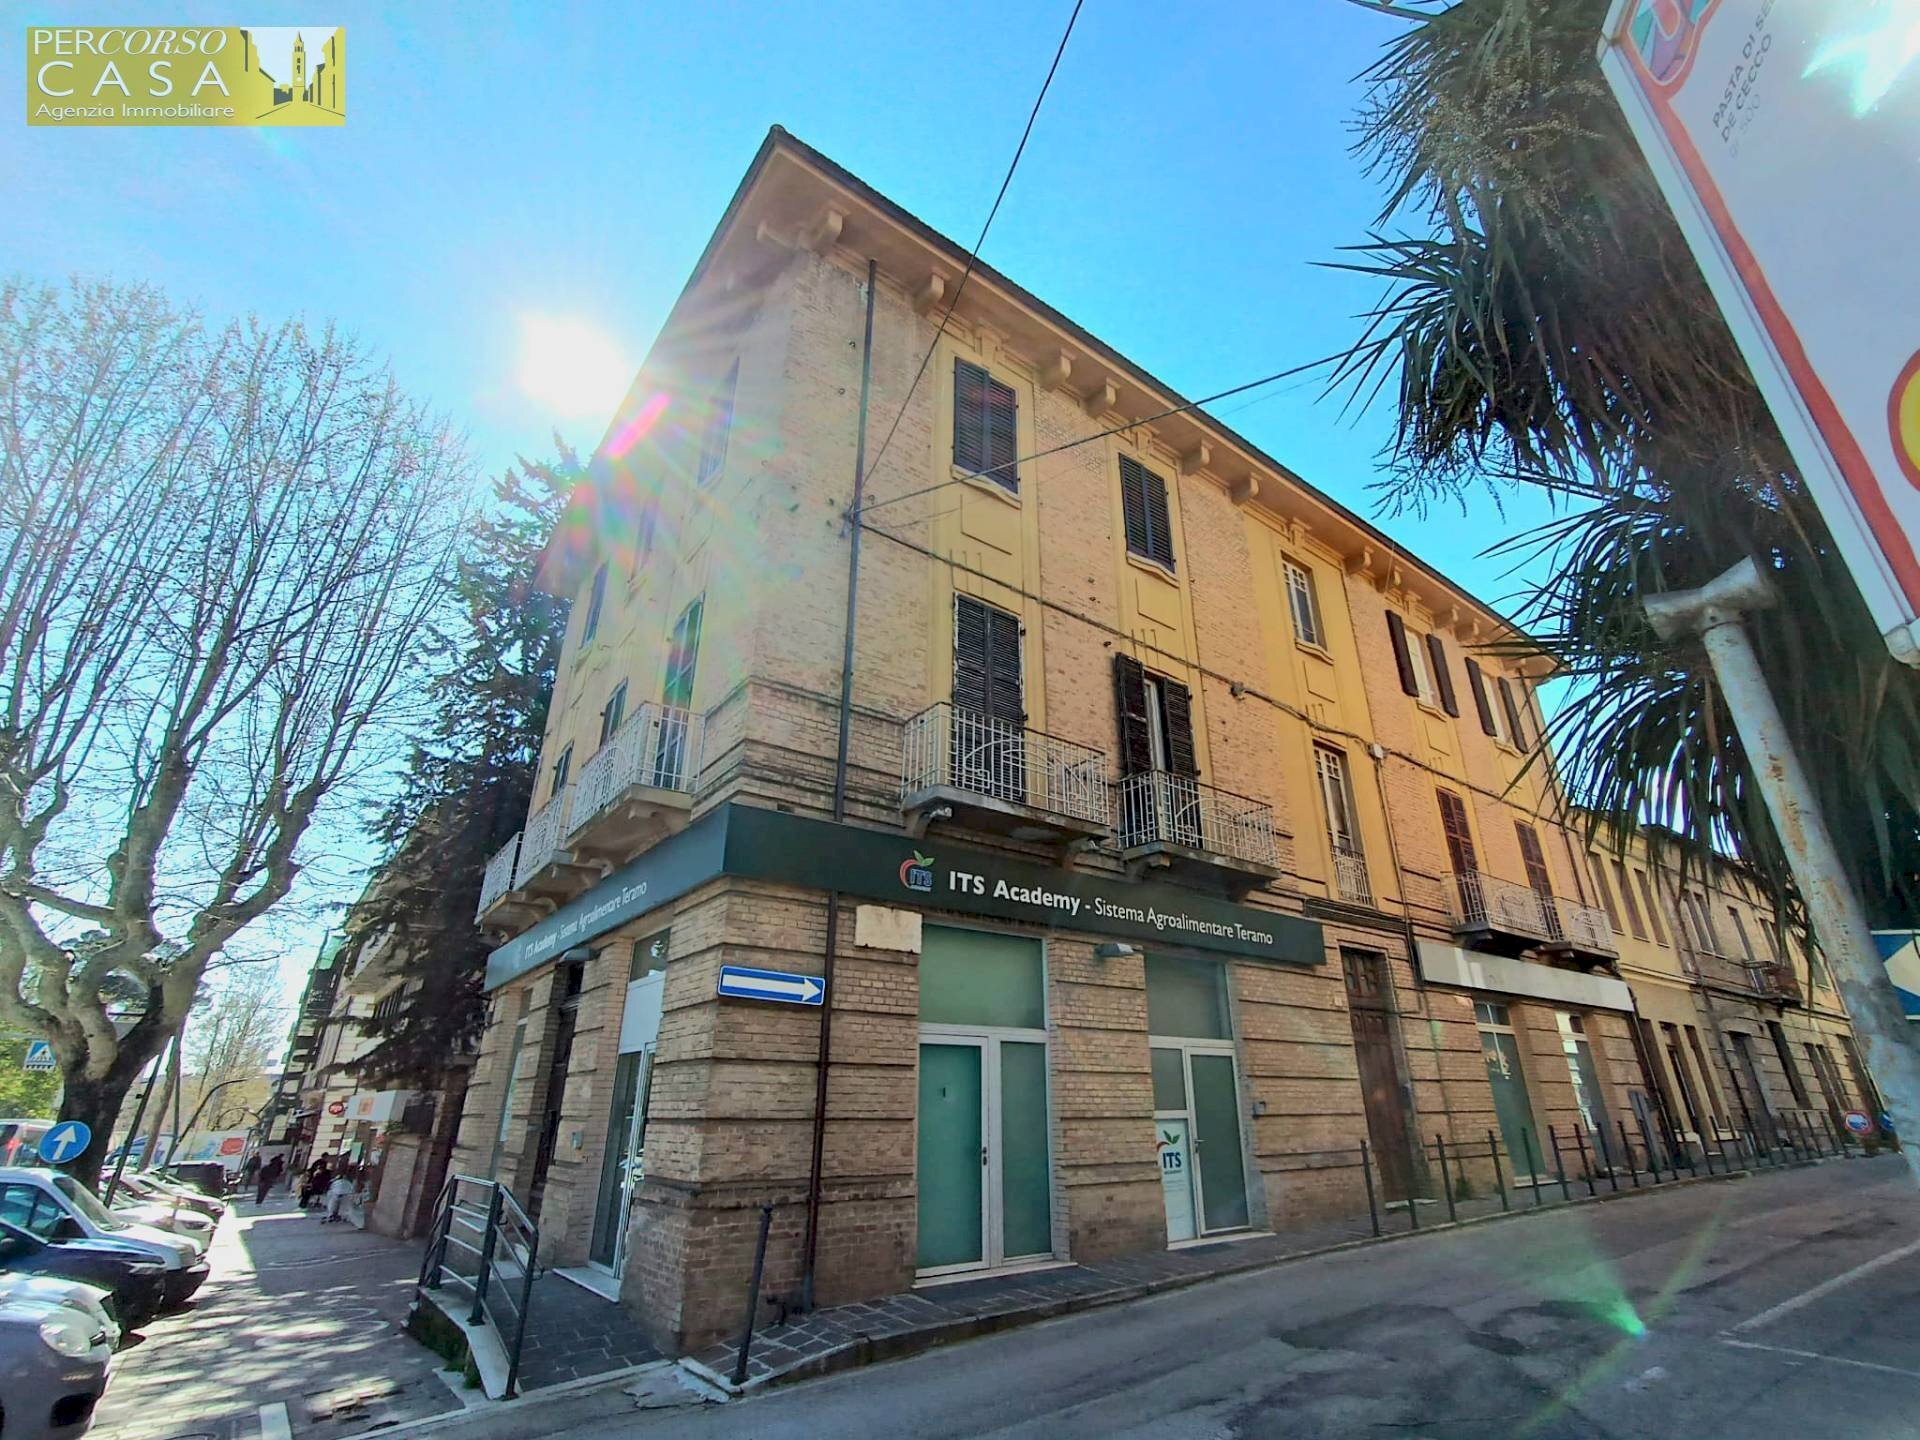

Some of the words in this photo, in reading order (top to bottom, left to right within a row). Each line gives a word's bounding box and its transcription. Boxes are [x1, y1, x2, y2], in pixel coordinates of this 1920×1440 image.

[1712, 65, 1744, 128] PASTA
[1742, 34, 1756, 59] DI
[1721, 112, 1737, 143] DE
[1736, 34, 1772, 110] CECCO
[621, 881, 647, 905] Teramo
[910, 868, 932, 887] ITS
[949, 870, 985, 895] ITS
[993, 879, 1081, 916] Academy
[1094, 897, 1145, 923] Sistema
[1146, 907, 1235, 938] Agroalimentare
[1234, 923, 1274, 945] Teramo
[1162, 1152, 1182, 1169] ITS
